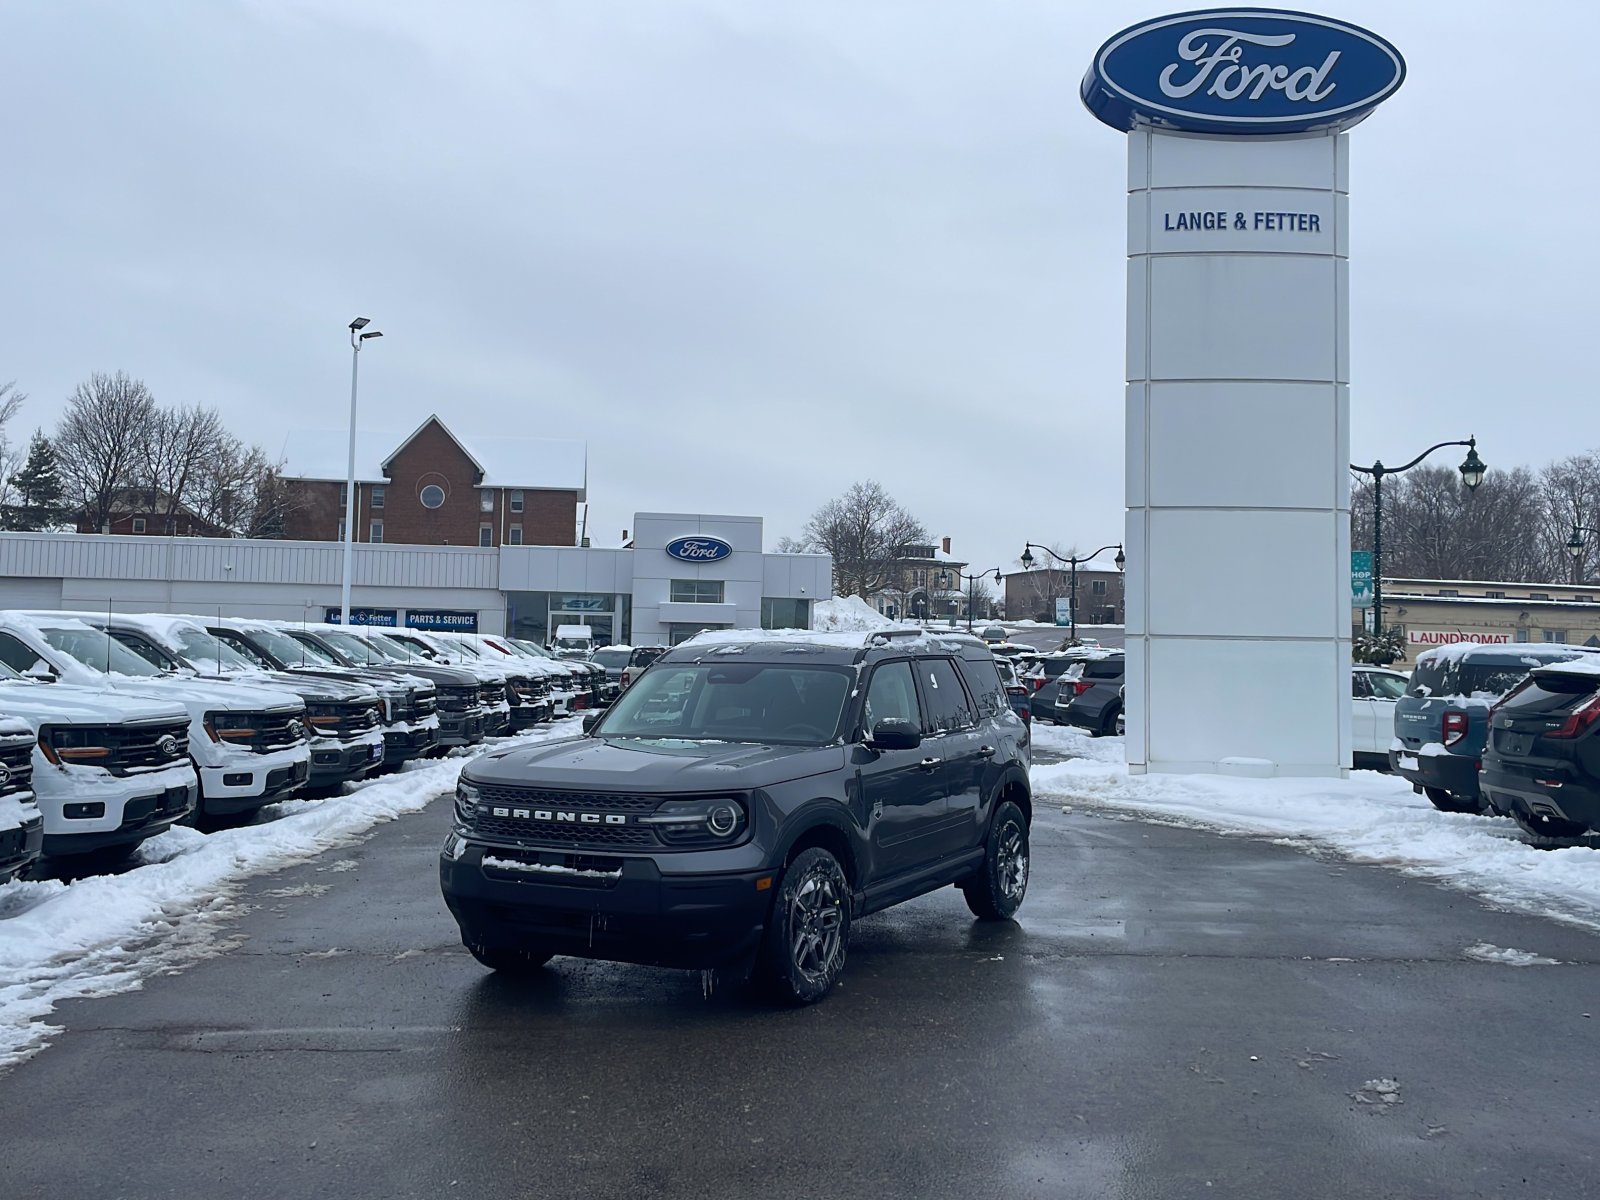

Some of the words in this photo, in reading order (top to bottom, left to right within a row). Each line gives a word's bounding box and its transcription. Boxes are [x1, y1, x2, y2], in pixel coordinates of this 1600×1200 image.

[1159, 28, 1341, 102] Ford
[1164, 211, 1227, 231] LANGE
[1234, 212, 1247, 231] &
[1254, 212, 1321, 233] FETTER
[679, 540, 718, 558] Ford
[1351, 571, 1371, 579] HOP
[331, 613, 355, 621] Lae
[368, 614, 392, 622] Fetter
[410, 614, 434, 624] PARTS
[435, 615, 442, 624] &
[443, 615, 474, 625] SERVICE
[1410, 631, 1510, 644] LAUNDROMAT
[493, 807, 626, 825] BRONCO
